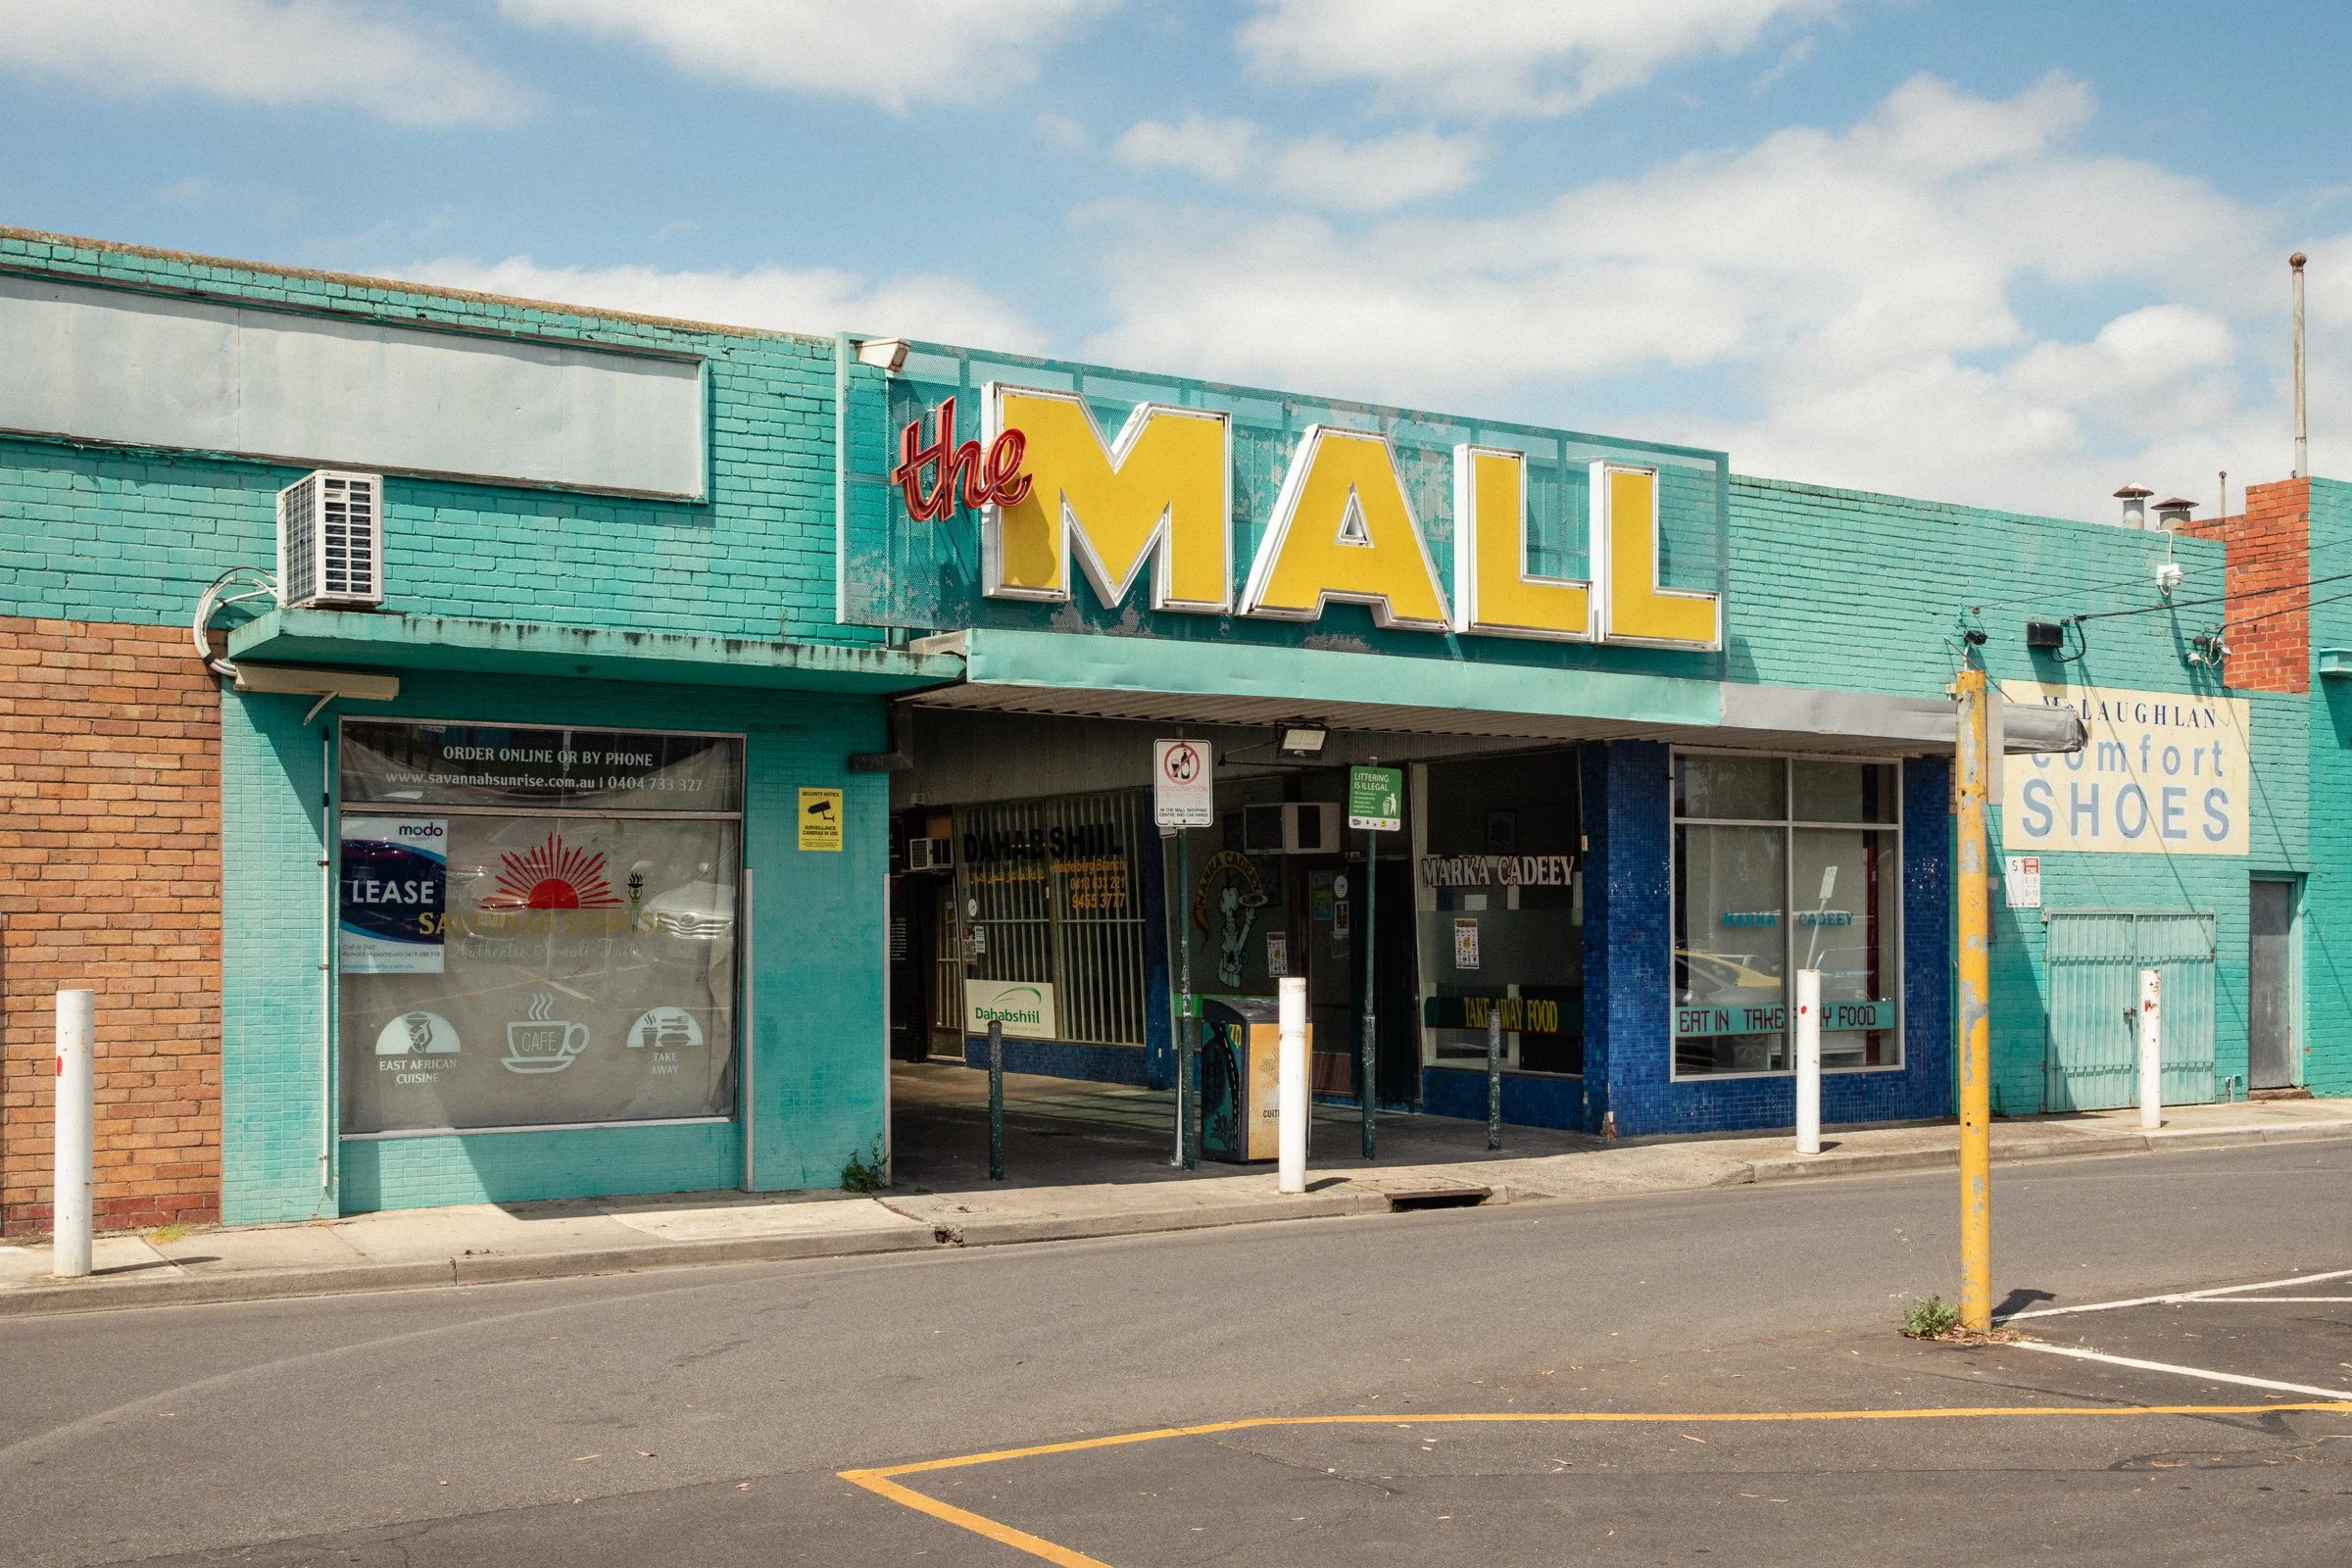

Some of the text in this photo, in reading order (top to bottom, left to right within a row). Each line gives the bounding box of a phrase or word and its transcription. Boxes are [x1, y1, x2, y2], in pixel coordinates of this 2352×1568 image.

[891, 394, 1034, 523] the
[981, 381, 1722, 653] MALL
[443, 746, 654, 766] ORDER ONLINE OR BY PHONE
[385, 771, 595, 789] www.savannahsunrise.com.au
[608, 775, 646, 790] 0404
[649, 777, 675, 792] 733
[678, 779, 705, 792] 327
[1354, 772, 1390, 783] LITTERING
[1361, 782, 1389, 792] ILLEGAL
[2022, 777, 2230, 843] SHOES
[399, 821, 443, 837] modo
[1096, 858, 1126, 871] Branch
[1422, 855, 1576, 887] MARKA CADEEY
[353, 880, 434, 904] LEASE
[1100, 892, 1126, 909] 3777
[1723, 911, 1854, 927] MARKA CADEEY
[975, 1007, 1040, 1024] Dahabshiil
[1463, 997, 1558, 1033] TAKE AWAY FOOD
[1680, 1010, 1710, 1033] EAT
[1715, 1009, 1730, 1032] IN
[1743, 1004, 1785, 1030] TAKE
[1838, 1005, 1877, 1027] FOOD
[521, 1030, 558, 1053] CAFE
[379, 1058, 458, 1071] EAST AFRICAN
[653, 1052, 678, 1062] TAKE
[396, 1072, 440, 1085] CUISINE
[651, 1064, 678, 1075] AWAY
